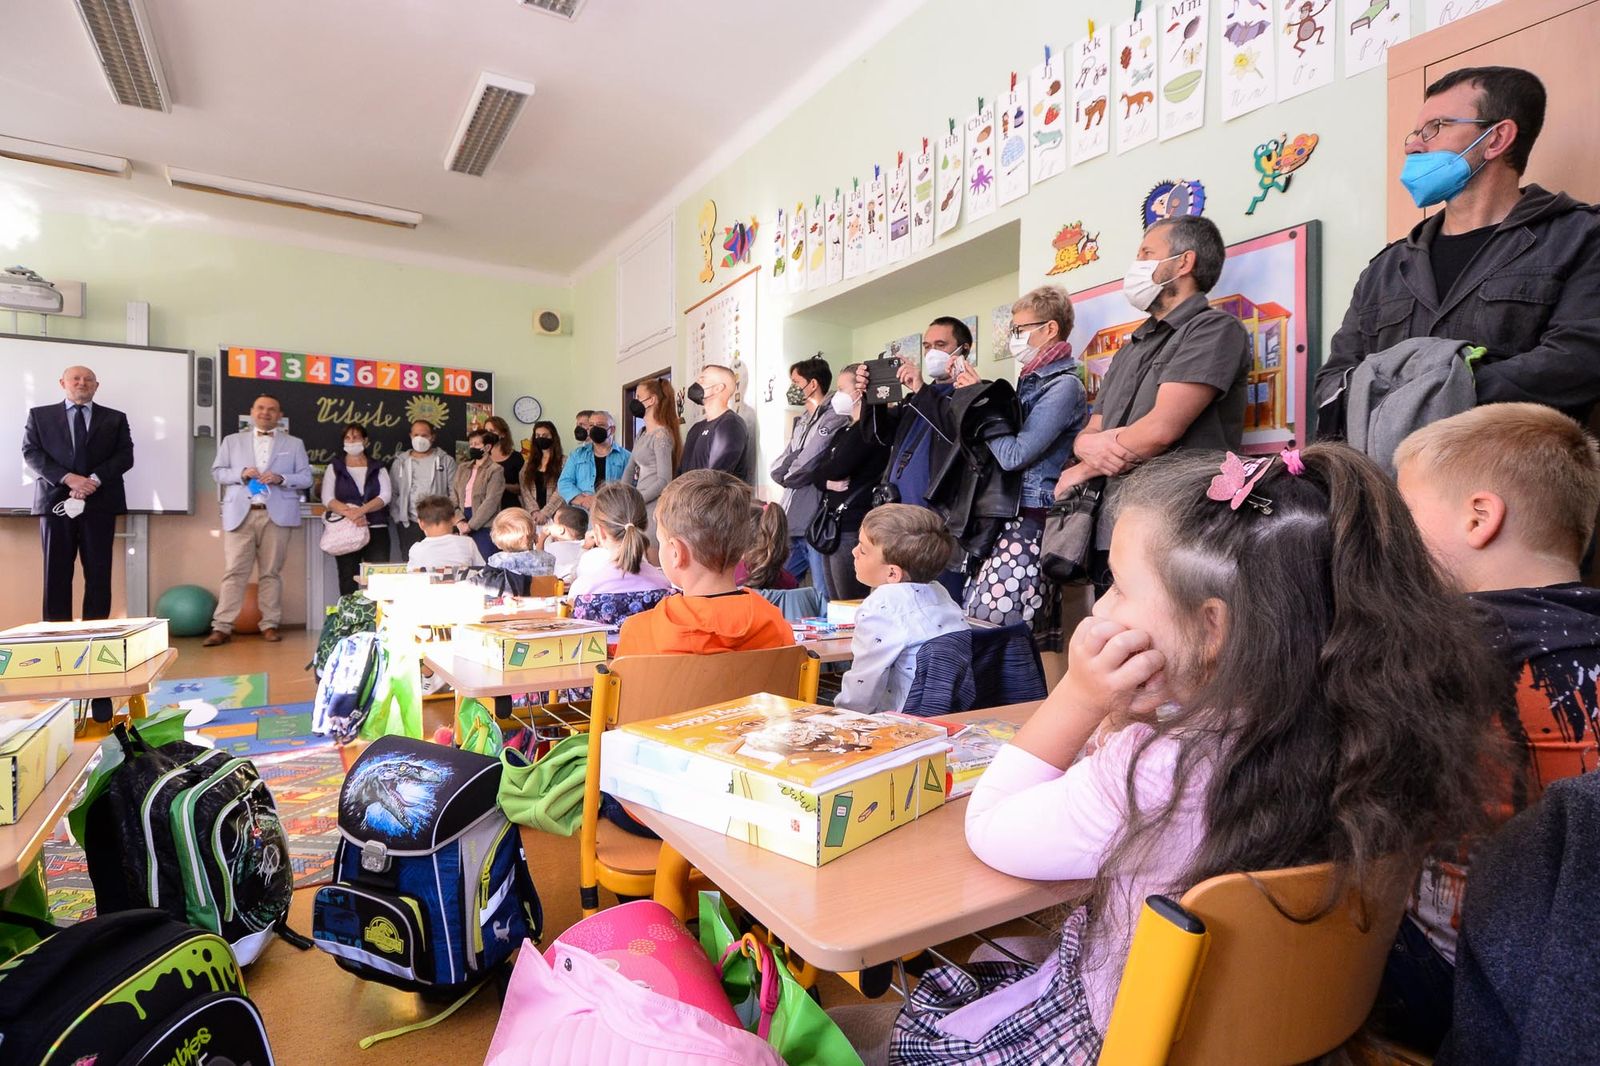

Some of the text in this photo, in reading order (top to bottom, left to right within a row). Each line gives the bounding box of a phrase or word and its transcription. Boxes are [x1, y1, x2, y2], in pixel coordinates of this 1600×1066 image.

[235, 354, 470, 394] 1 2 3 4 5 6 7 8 9 10
